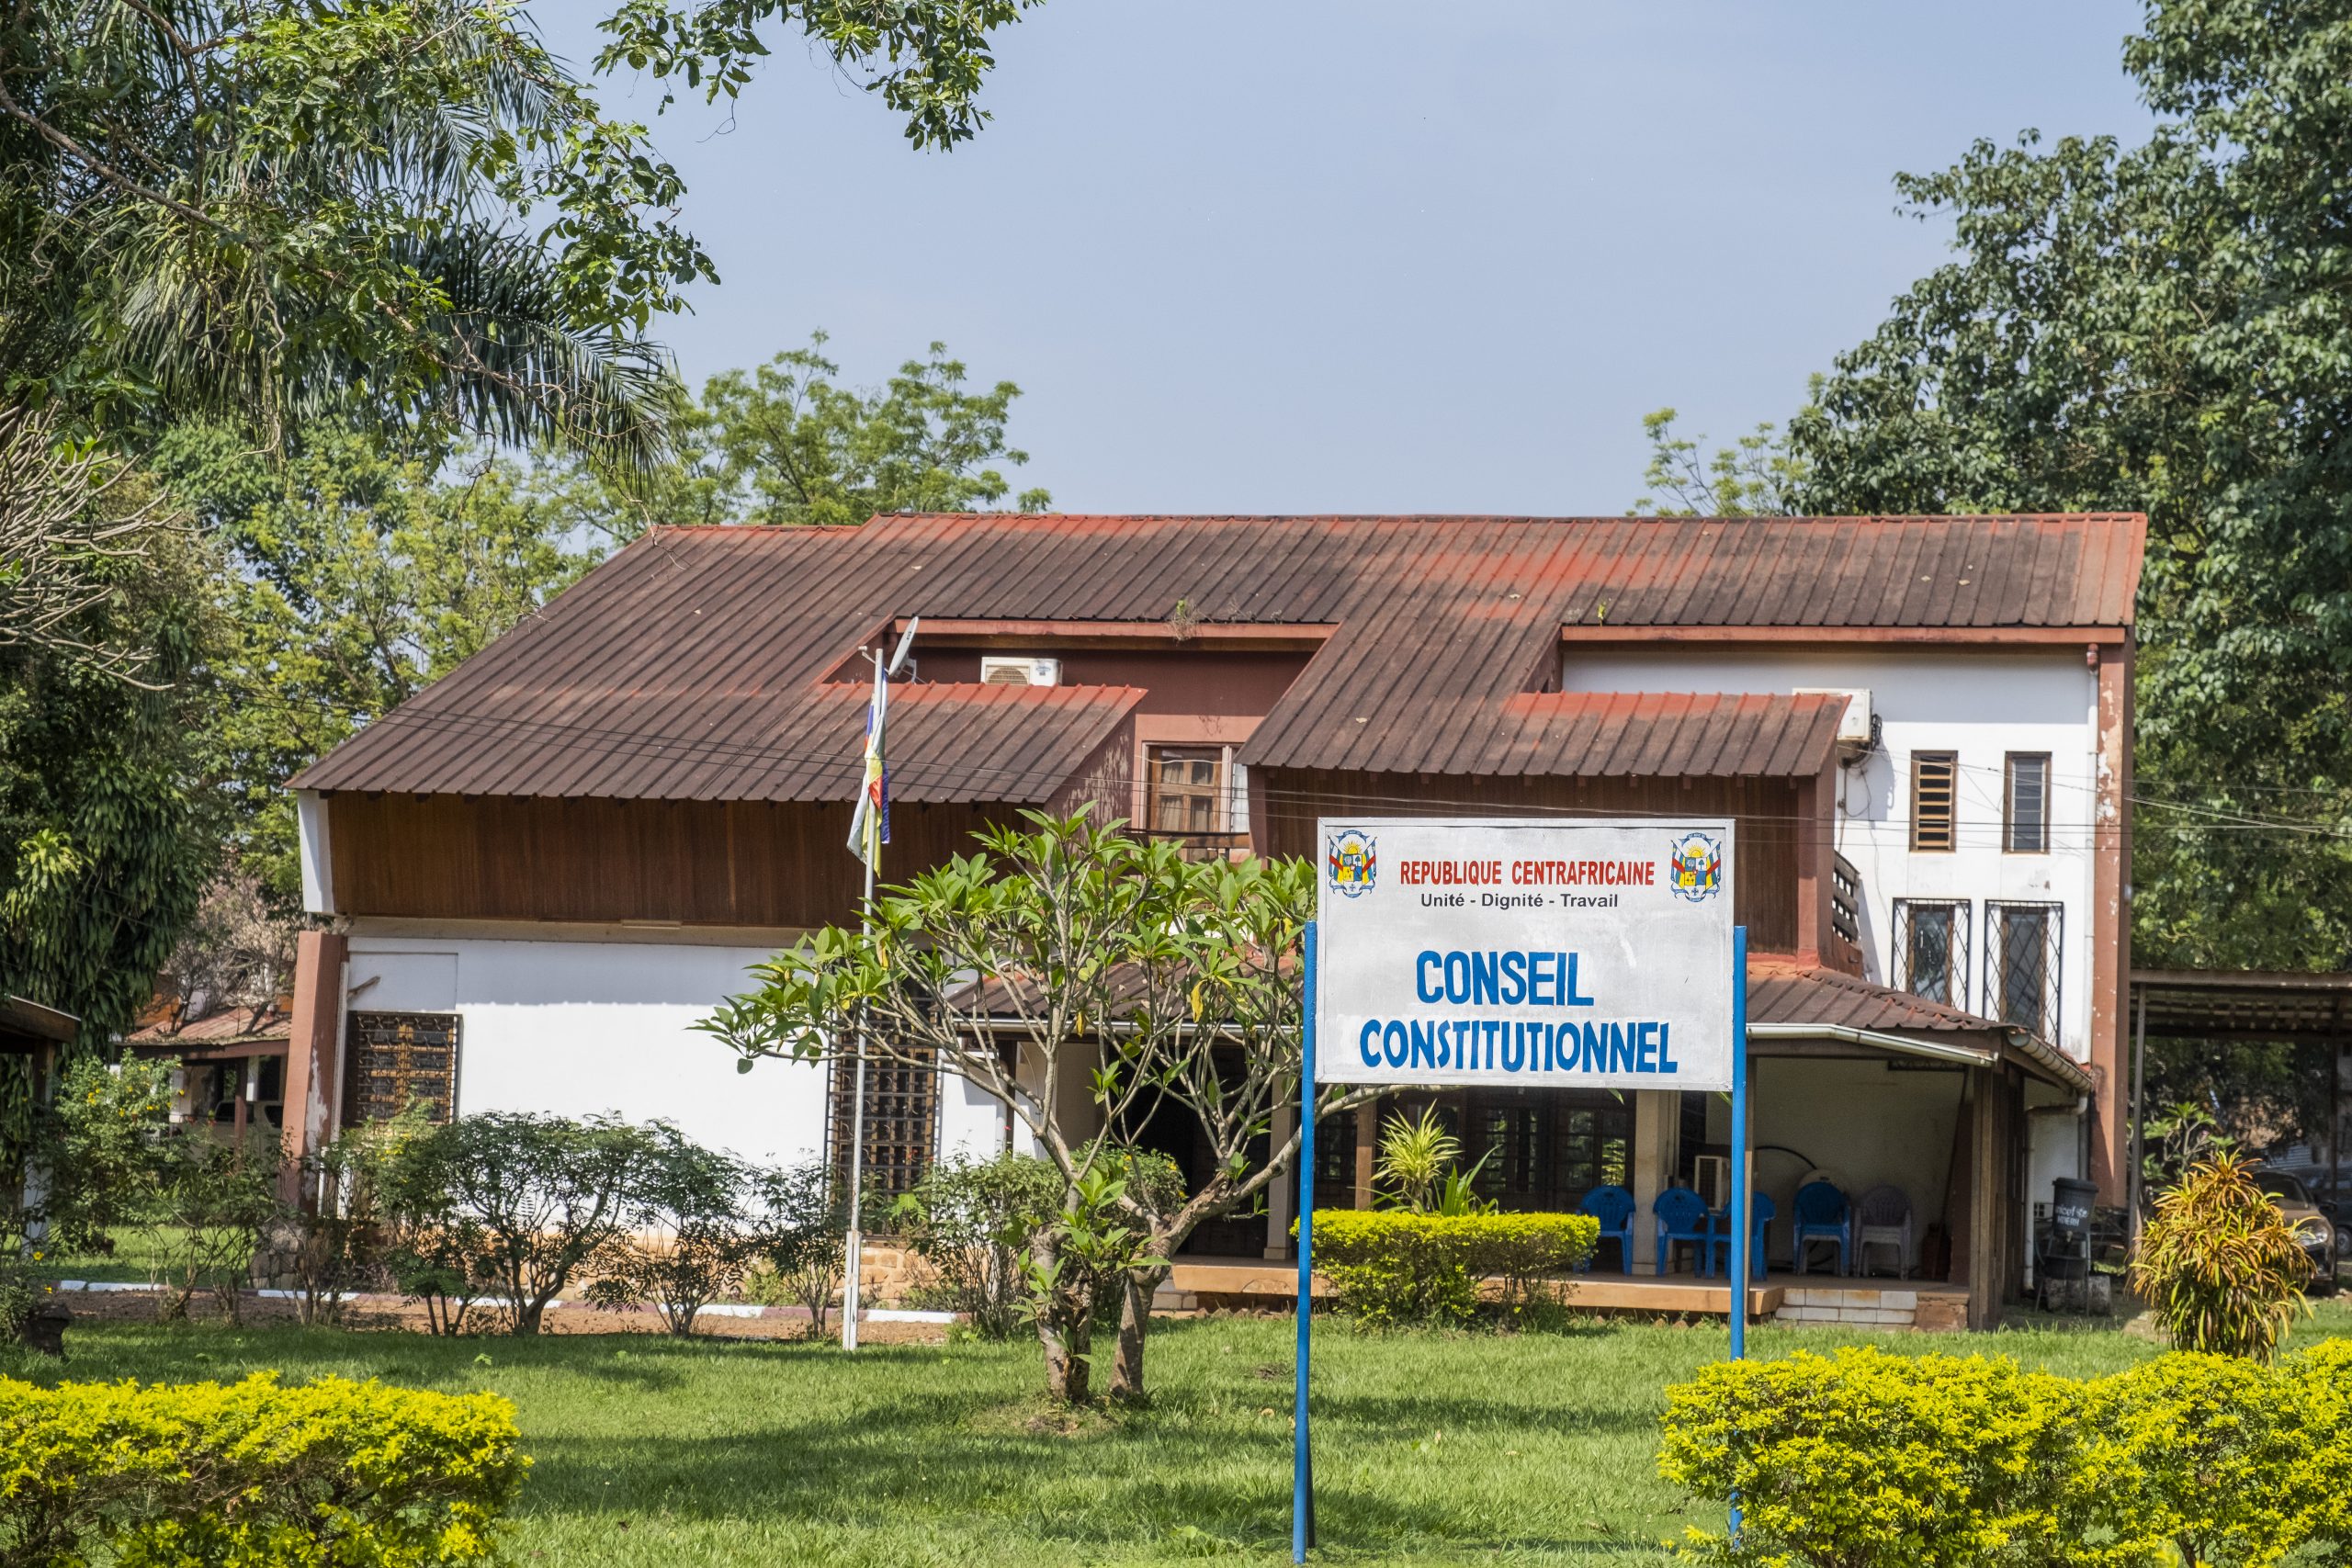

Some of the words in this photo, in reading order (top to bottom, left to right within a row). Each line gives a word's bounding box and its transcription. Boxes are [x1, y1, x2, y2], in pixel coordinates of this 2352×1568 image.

[1400, 861, 1502, 886] REPUBLIQUE
[1511, 861, 1655, 886] CENTRAFRICAINE
[1420, 893, 1465, 908] Unité
[1481, 893, 1544, 910] Dignité
[1560, 893, 1619, 908] Travail
[1416, 950, 1595, 1008] CONSEIL
[1359, 1019, 1679, 1074] CONSTITUTIONNEL
